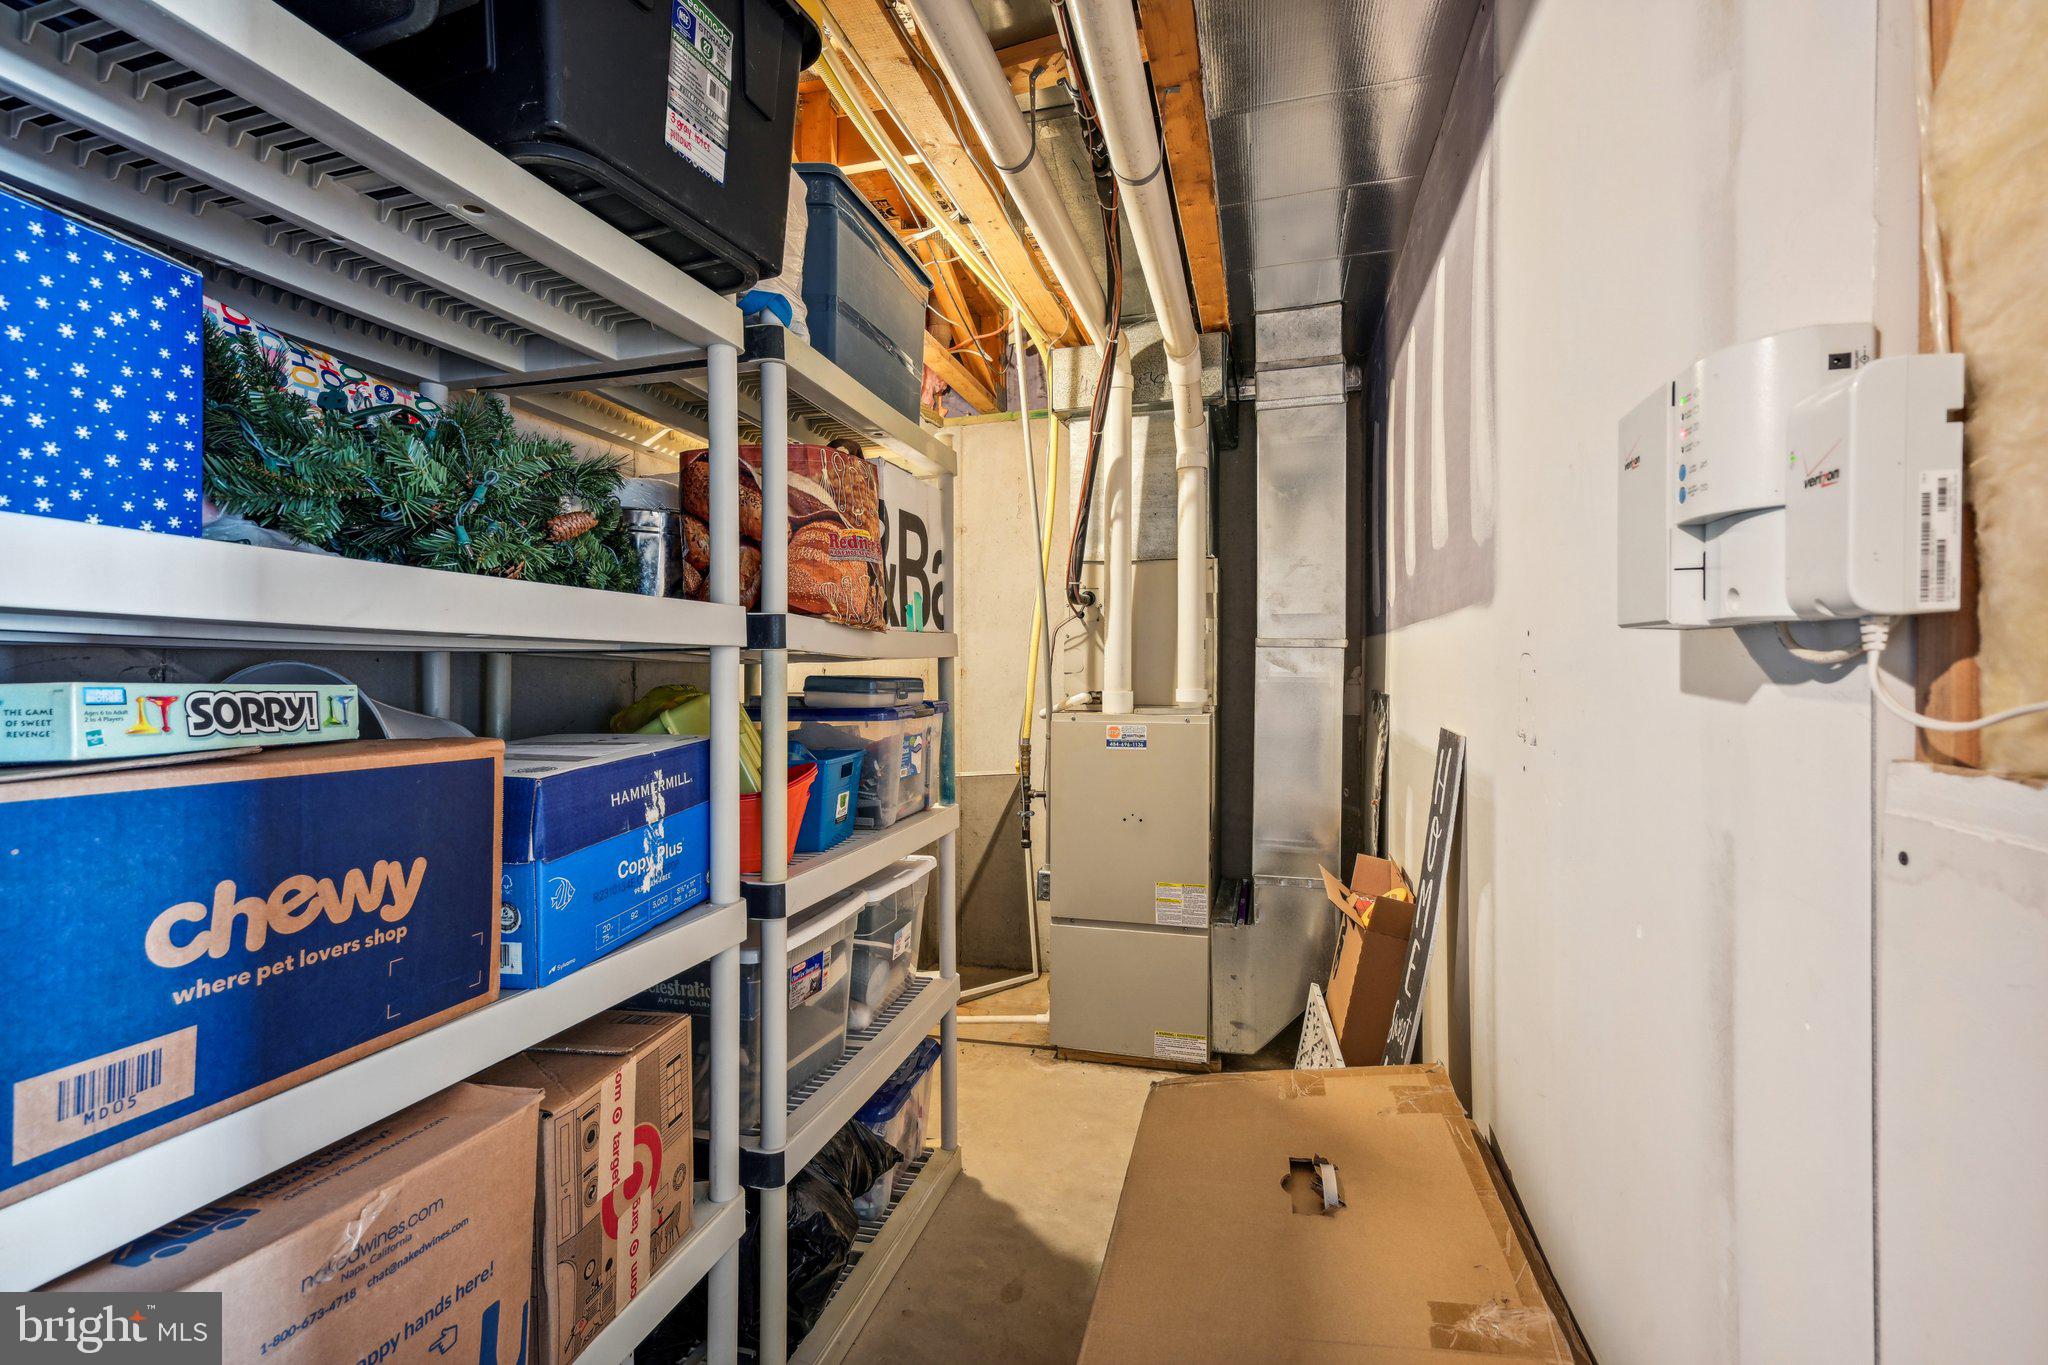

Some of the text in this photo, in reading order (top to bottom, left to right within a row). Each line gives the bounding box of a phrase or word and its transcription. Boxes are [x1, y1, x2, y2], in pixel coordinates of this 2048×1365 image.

[1624, 455, 1640, 471] verizon
[1804, 468, 1840, 489] verizon
[5, 719, 51, 727] OF SWEET
[188, 693, 317, 734] SORRY!
[6, 730, 51, 738] REVENGE
[611, 771, 691, 807] HAMMERMILL
[618, 841, 683, 879] Copy Plus
[145, 857, 427, 968] chewy
[602, 923, 611, 934] 20
[630, 911, 639, 920] 92
[172, 926, 408, 1006] where pet lovers shop
[657, 996, 685, 1005] AFTER
[610, 1131, 622, 1190] target
[341, 1233, 412, 1284] Napa, California
[260, 1217, 469, 1356] 1-800-673-4718 chat@nakedwines.com
[404, 1295, 452, 1341] hands
[455, 1260, 495, 1302] here!
